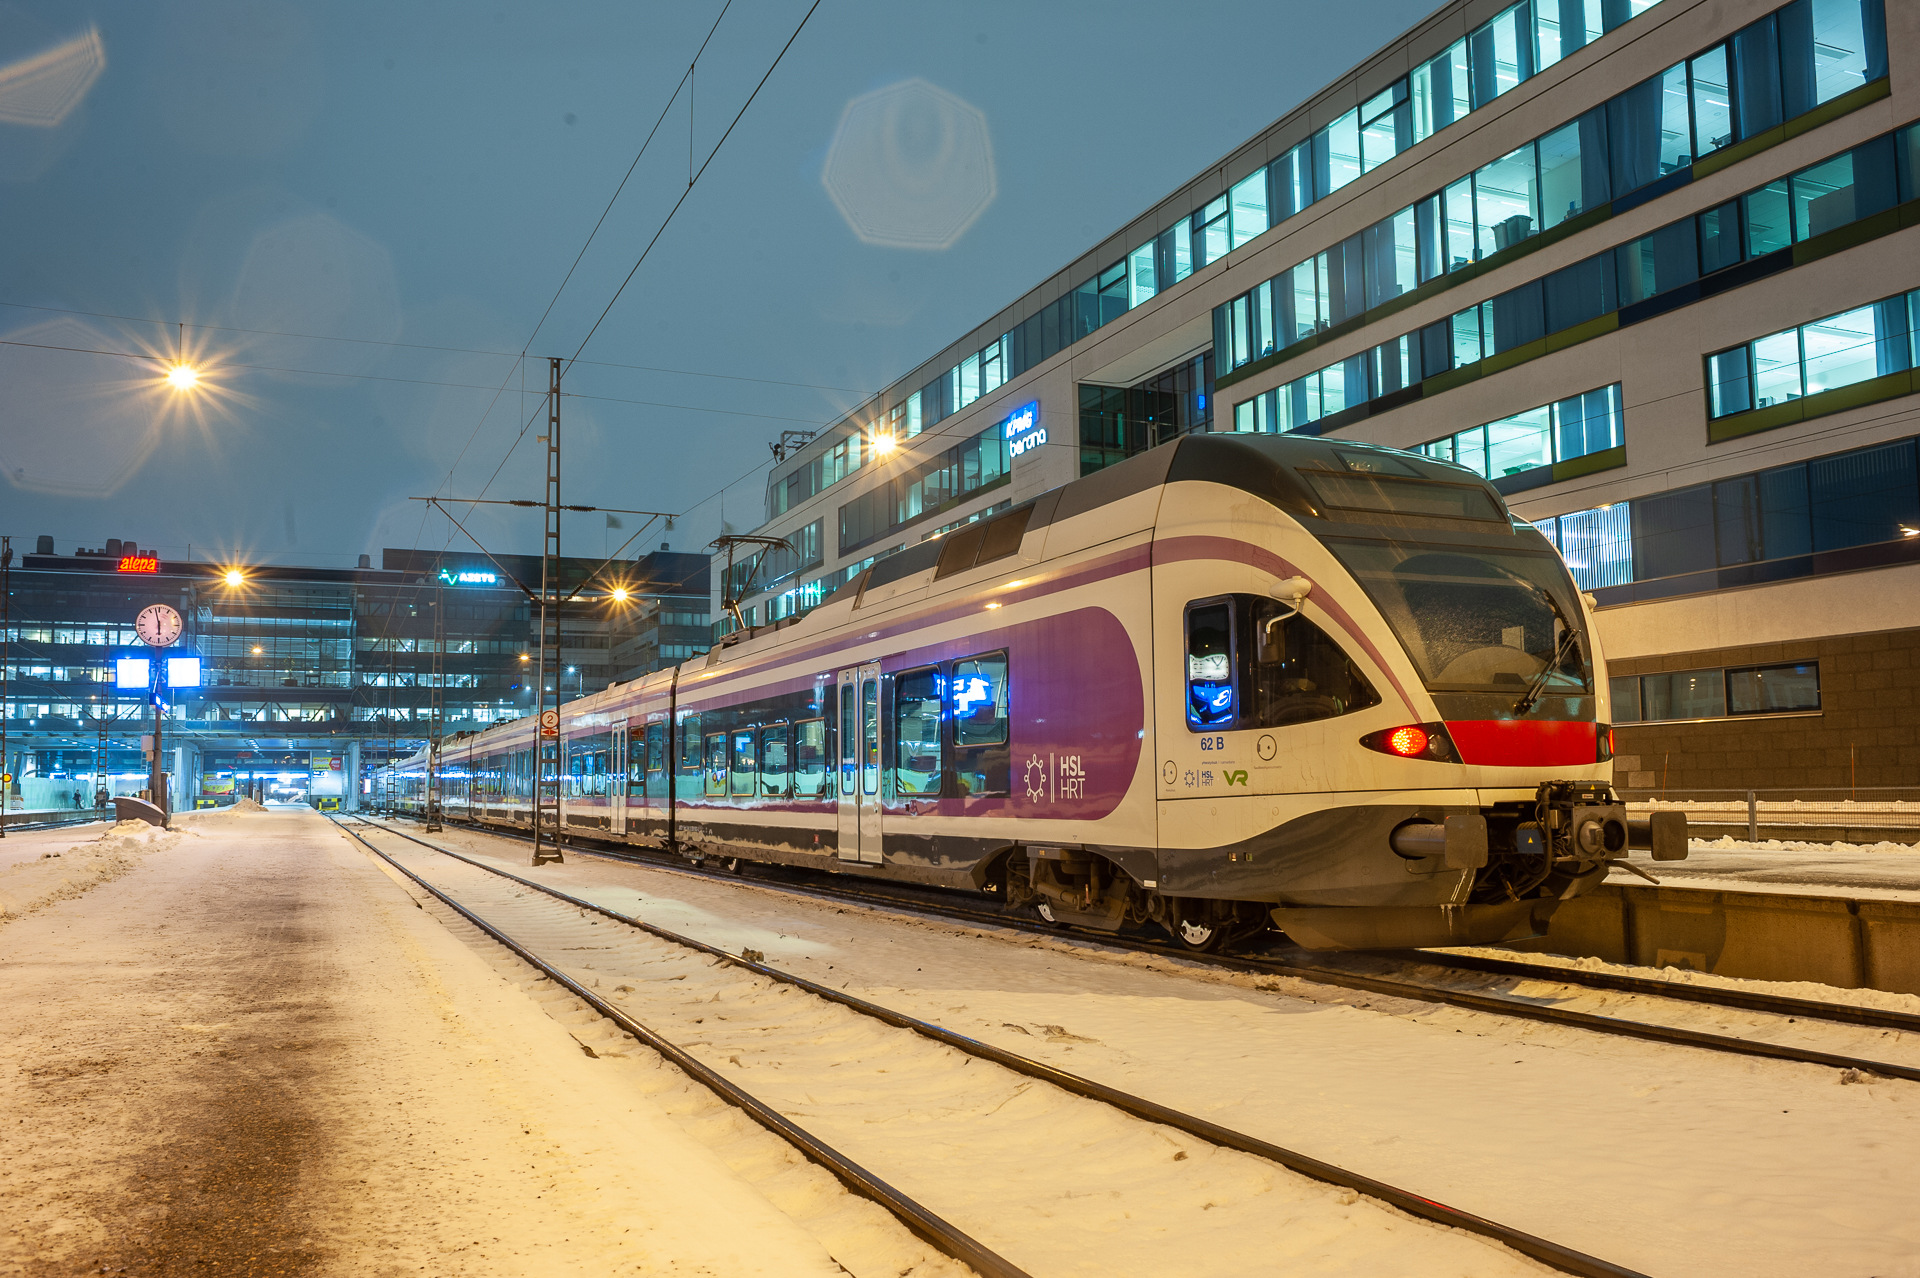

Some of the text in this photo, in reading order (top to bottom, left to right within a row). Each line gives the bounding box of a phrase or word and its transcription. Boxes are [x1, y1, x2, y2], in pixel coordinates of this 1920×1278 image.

[119, 556, 158, 572] alepa
[547, 714, 554, 724] 2
[1200, 736, 1225, 751] 62 B
[1060, 755, 1086, 777] HSL
[1201, 770, 1214, 779] HSL
[1222, 769, 1249, 787] VR
[1060, 778, 1086, 800] HRT
[1201, 779, 1214, 787] HRT
